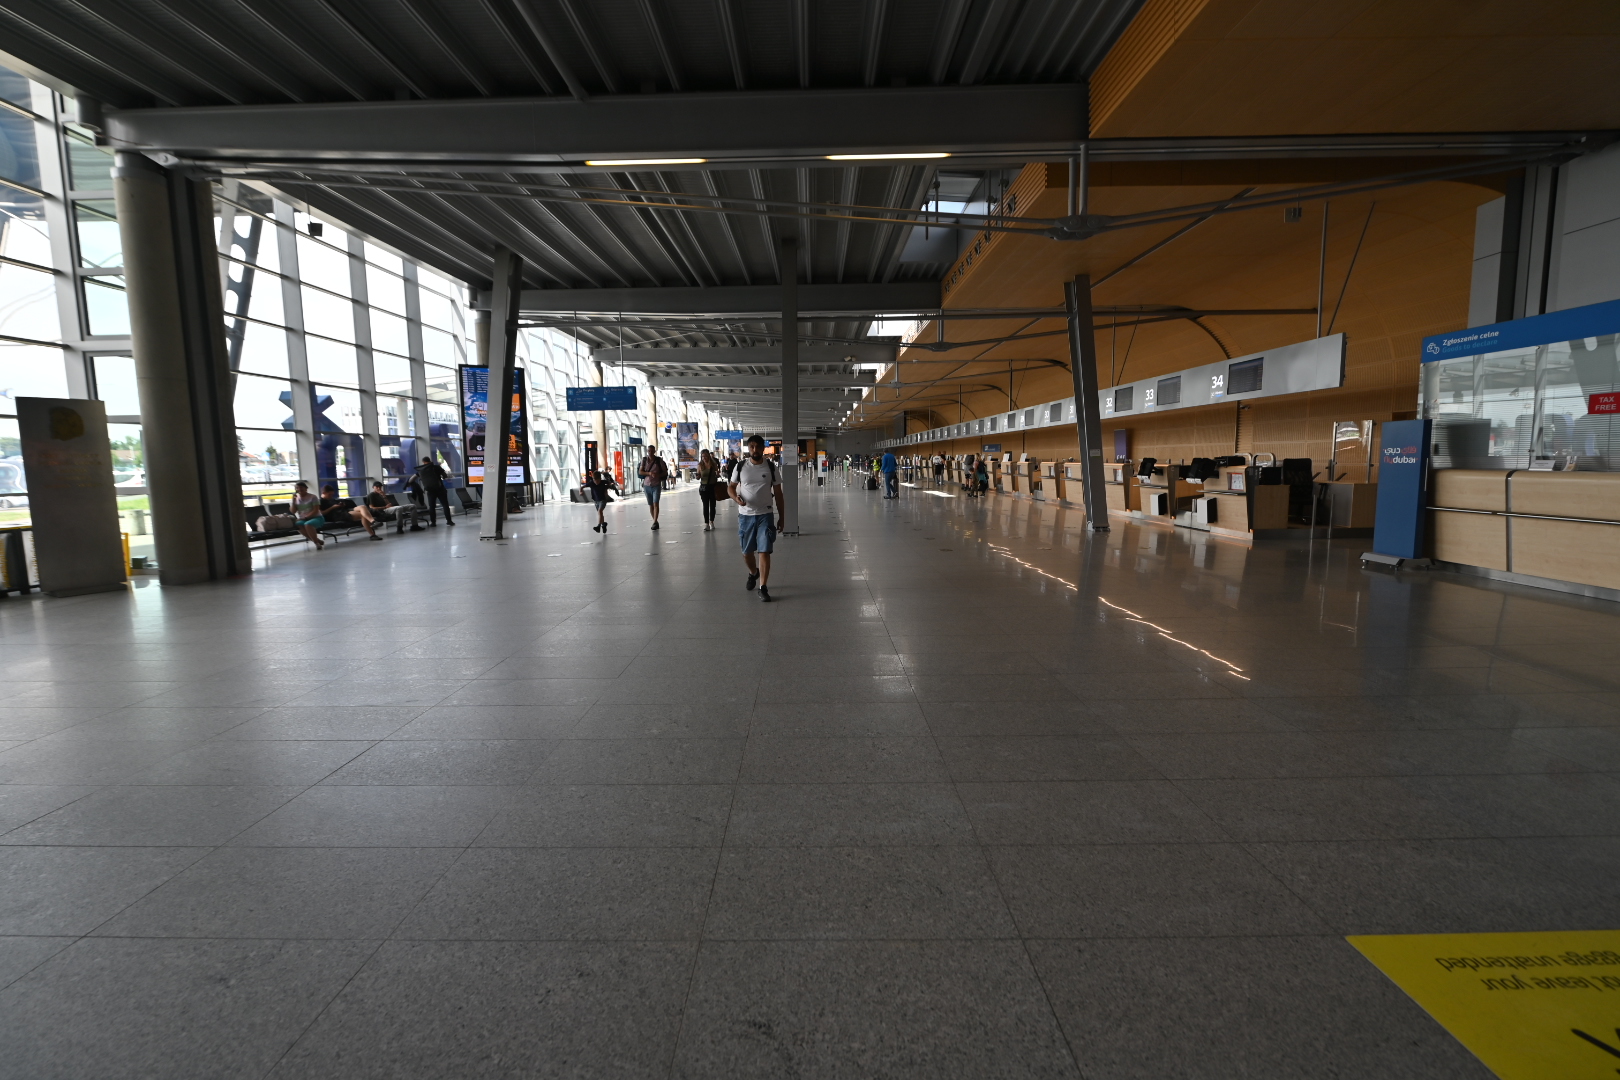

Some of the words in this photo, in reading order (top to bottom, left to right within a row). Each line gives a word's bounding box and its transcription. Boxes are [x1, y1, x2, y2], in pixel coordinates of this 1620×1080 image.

[1442, 333, 1479, 346] Zgłoszenie
[1479, 330, 1500, 339] celne
[1442, 345, 1462, 353] Goods
[1471, 339, 1498, 348] declare
[1211, 374, 1224, 389] 34
[1145, 388, 1154, 401] 33
[1105, 397, 1113, 408] 32
[1594, 403, 1617, 412] FREE
[1435, 956, 1561, 971] unattended
[1480, 974, 1534, 991] your
[1530, 976, 1603, 992] leave
